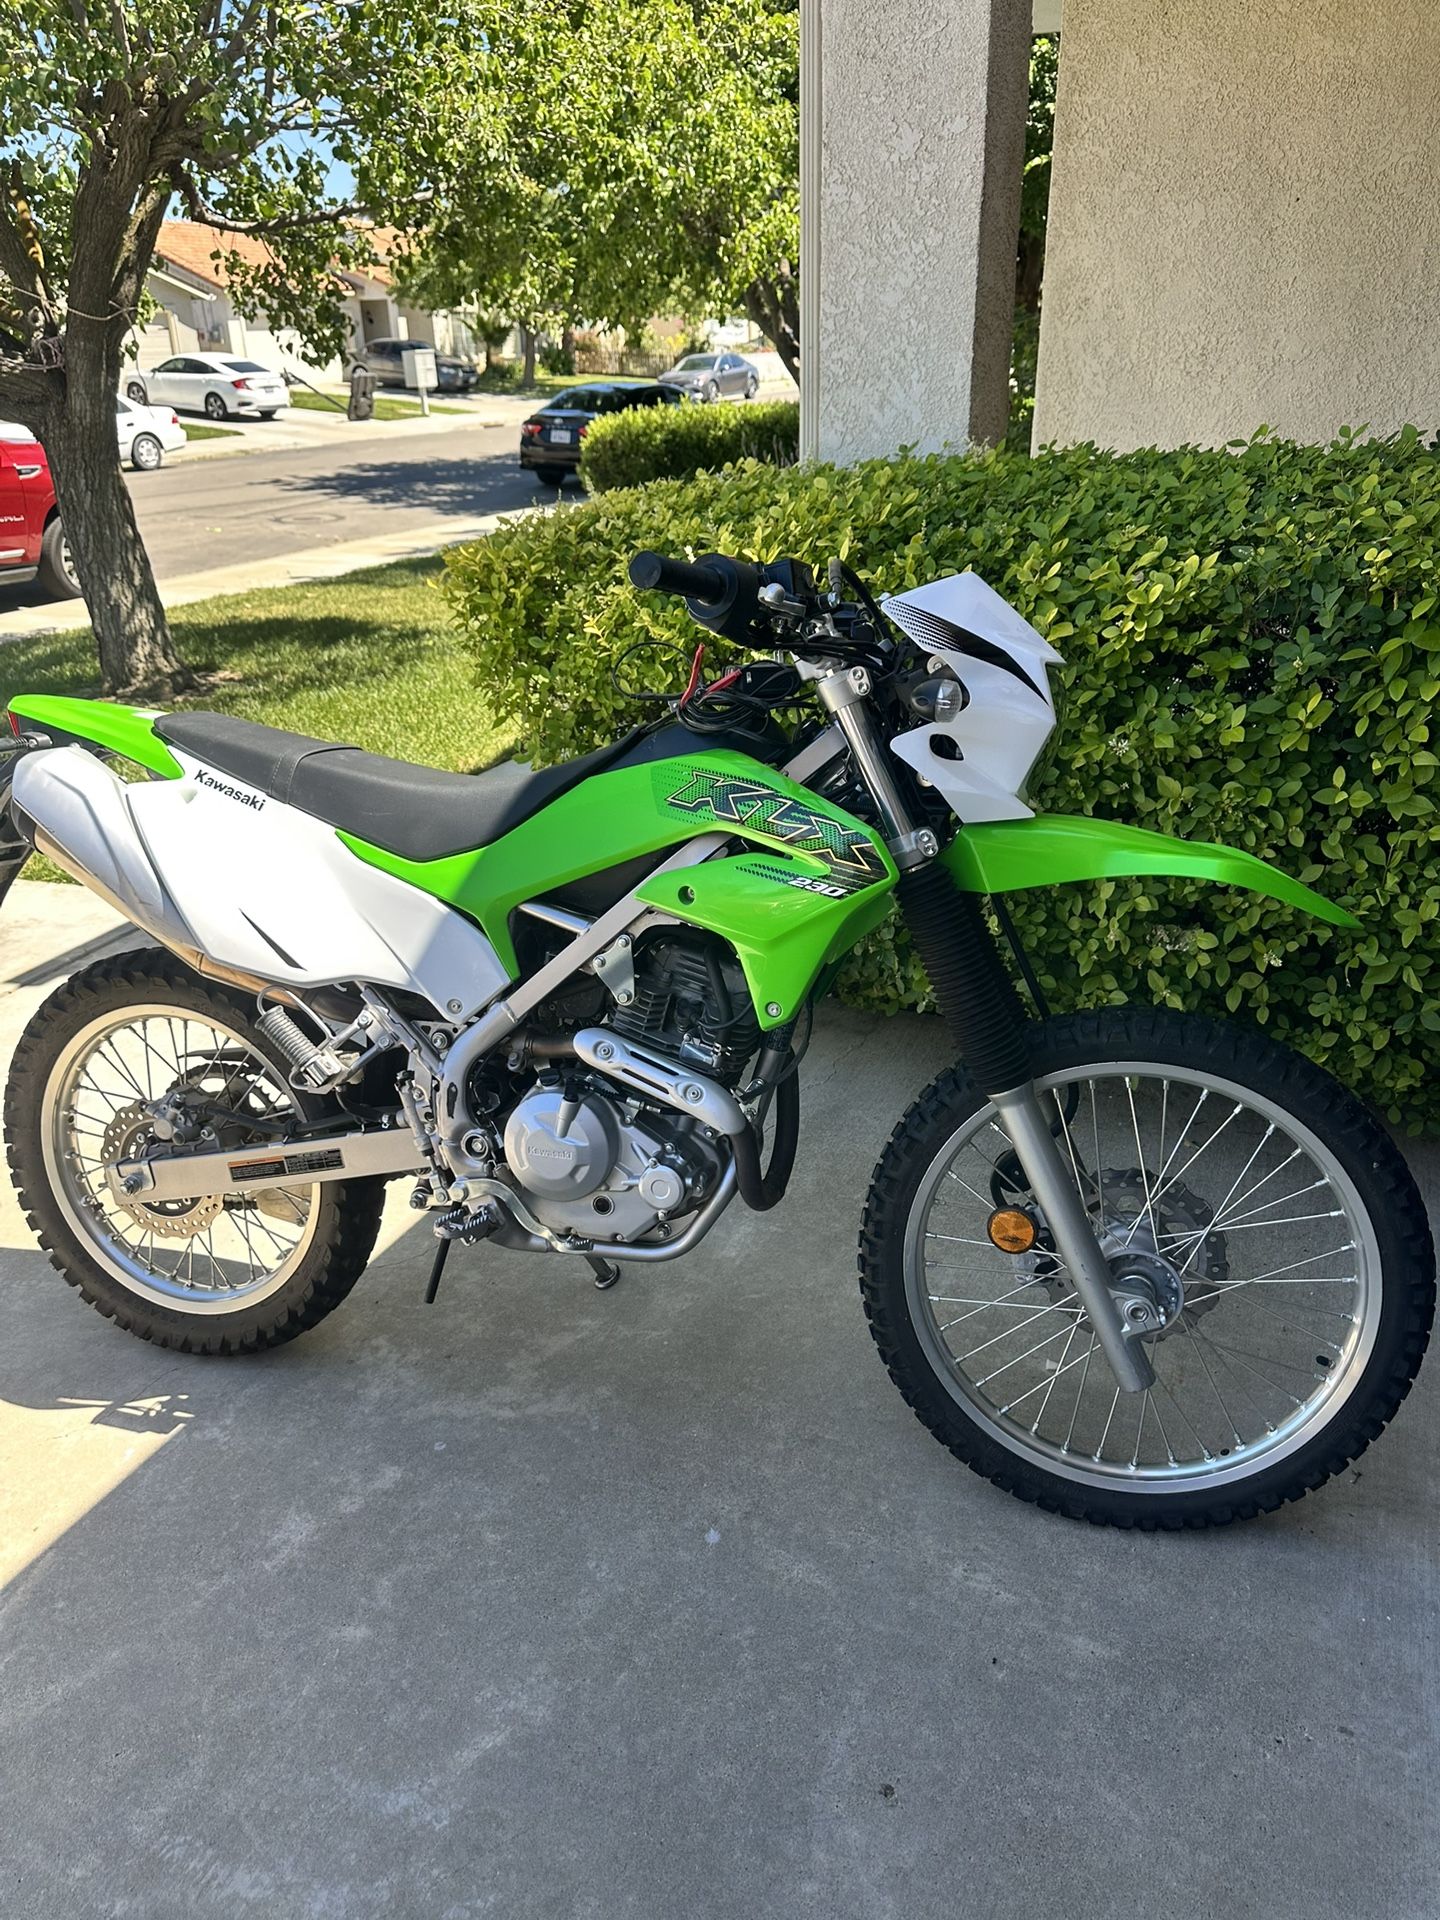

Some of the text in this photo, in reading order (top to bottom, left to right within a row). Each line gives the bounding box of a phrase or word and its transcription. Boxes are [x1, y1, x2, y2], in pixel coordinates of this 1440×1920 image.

[194, 769, 266, 811] Kawasaki
[666, 771, 873, 870] KLX
[789, 876, 848, 897] 230
